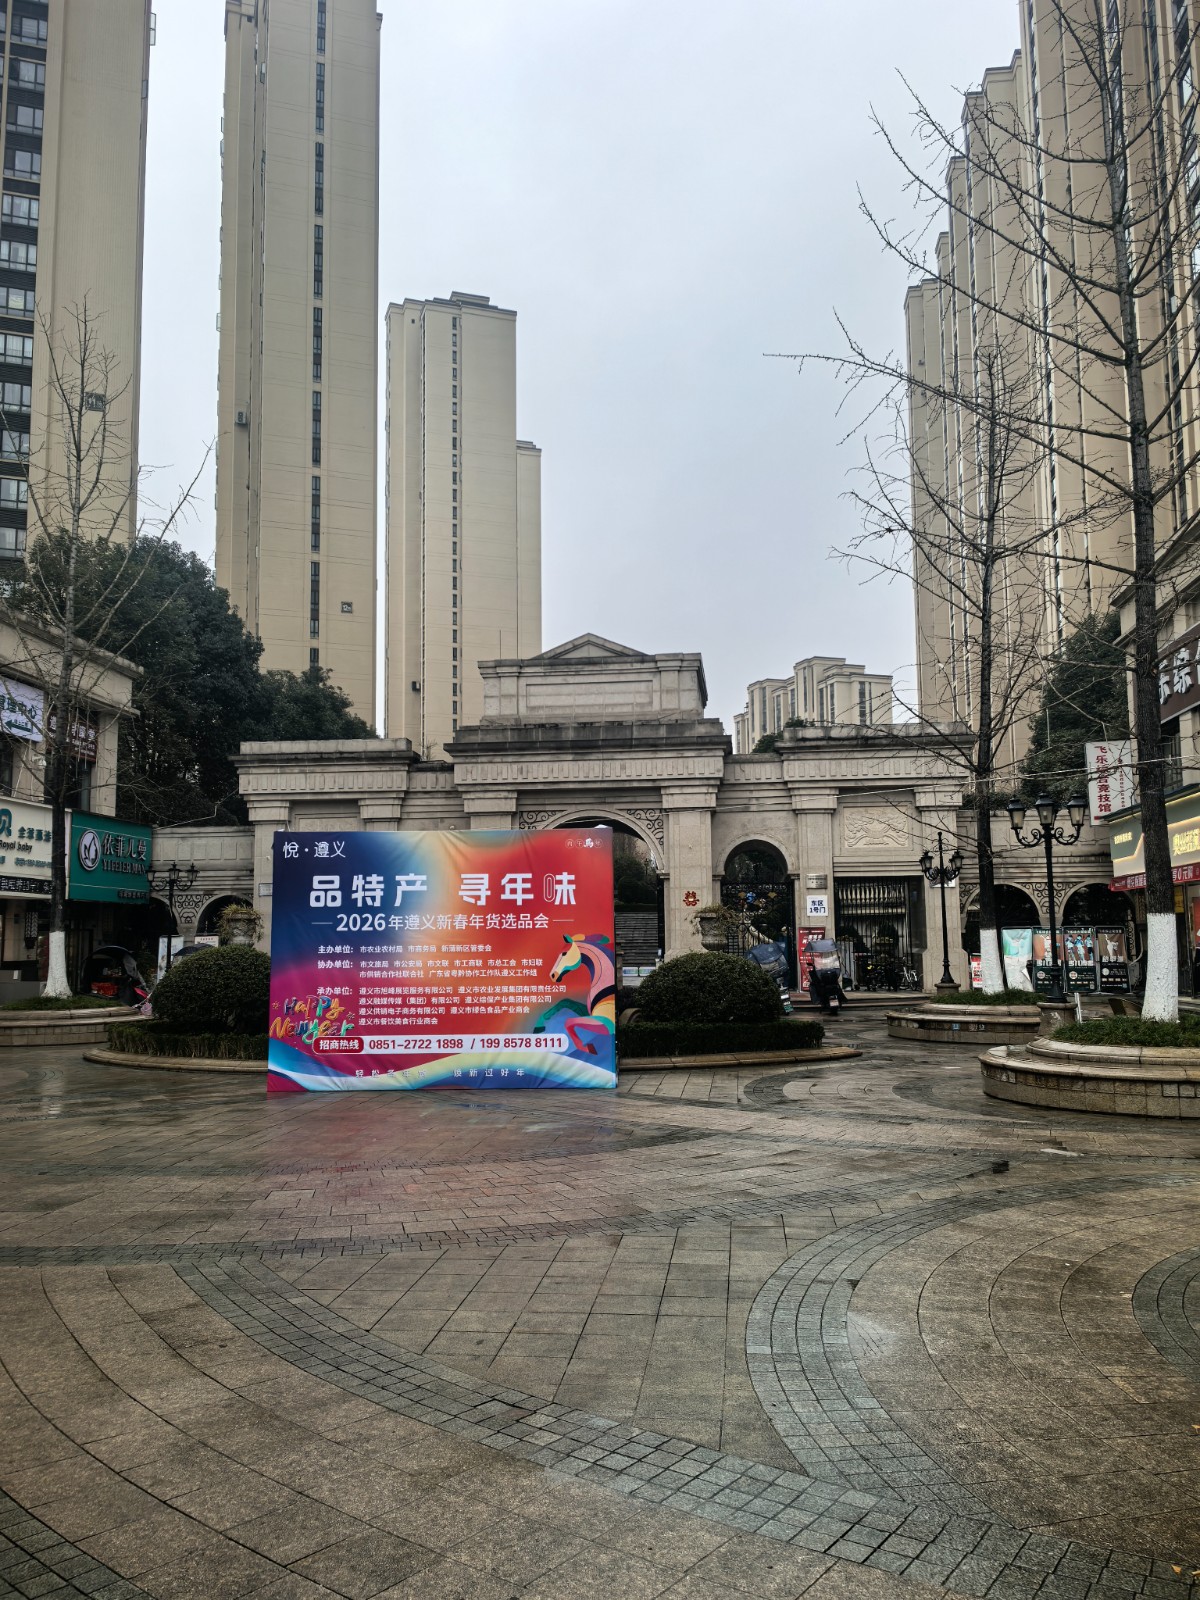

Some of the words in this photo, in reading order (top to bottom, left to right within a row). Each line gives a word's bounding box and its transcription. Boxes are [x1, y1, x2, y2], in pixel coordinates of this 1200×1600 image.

[17, 842, 32, 853] baby
[310, 873, 428, 908] 品特产
[458, 872, 576, 906] 寻年味
[336, 912, 550, 932] 2026年遵义新春年货选品会
[360, 945, 403, 954] 市农业农村局
[408, 945, 436, 953] 市商务局
[360, 960, 389, 968] 市文旅局
[394, 960, 423, 968] 市公安局
[427, 960, 449, 968] 市文联
[454, 959, 483, 967] 市工商联
[487, 959, 516, 967] 市总工会
[521, 958, 543, 966] 市妇联
[359, 970, 424, 979] 市供销合作社联合社
[458, 985, 566, 994] 遵义市农业发展集团有限责任公司
[358, 1007, 446, 1016] 遵义供销电子商务有限公司
[450, 1006, 530, 1014] 遵义市绿色食品产业商会
[358, 1017, 438, 1026] 遵义市餐饮美食行业商会
[319, 1039, 360, 1050] 招商热线
[436, 1039, 464, 1049] 1898
[480, 1038, 500, 1048] 199
[504, 1038, 532, 1048] 8578
[534, 1037, 562, 1048] 8111
